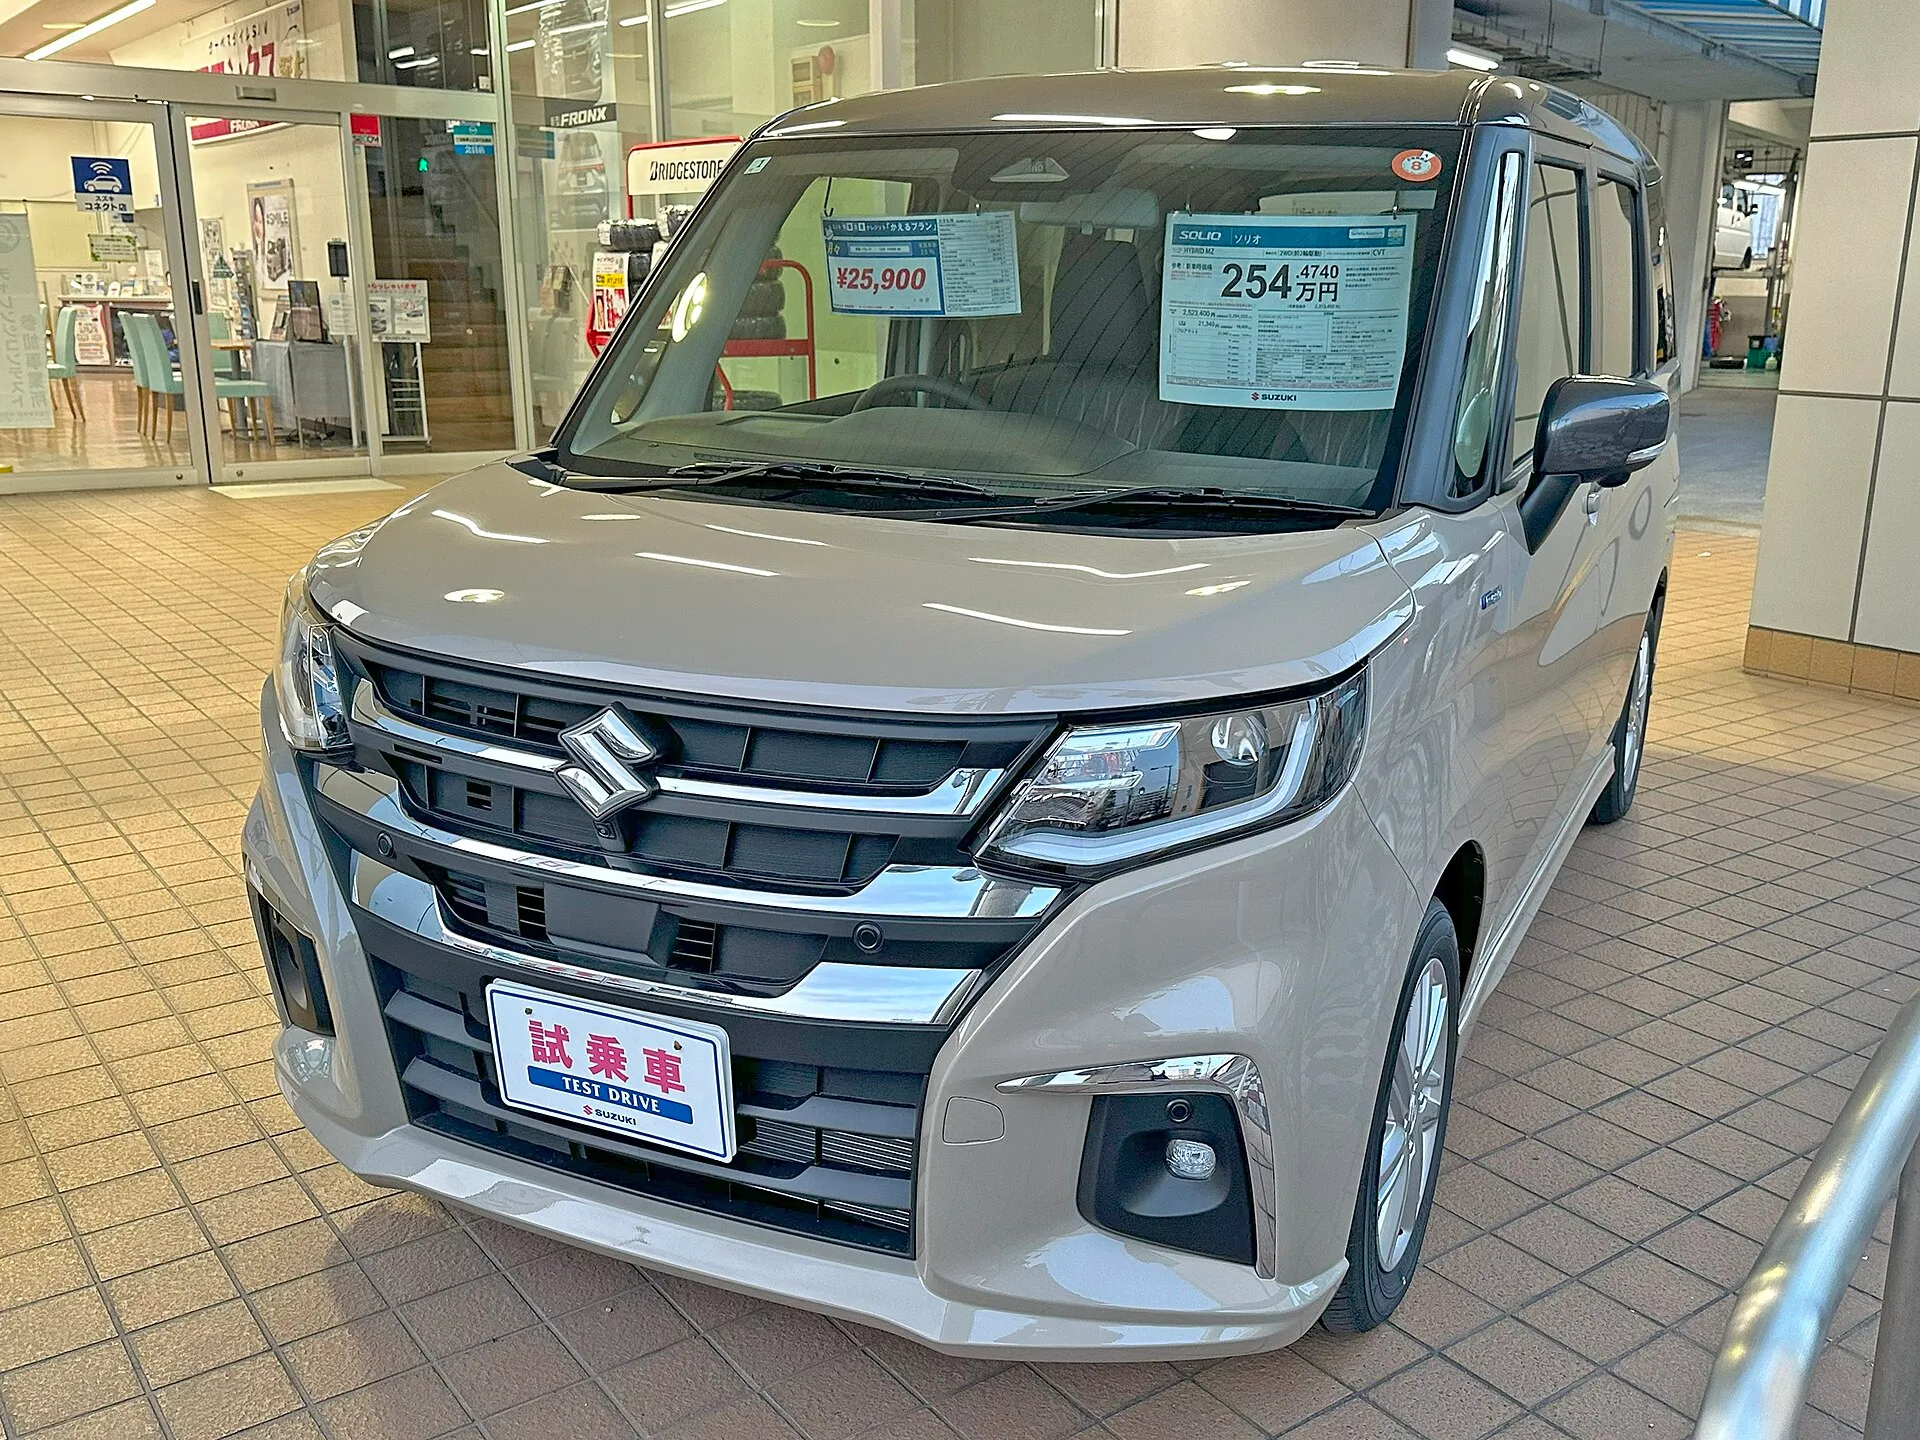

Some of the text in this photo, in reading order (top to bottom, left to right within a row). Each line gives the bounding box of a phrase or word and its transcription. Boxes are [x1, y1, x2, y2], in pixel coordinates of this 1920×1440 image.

[561, 106, 607, 127] FRONX
[650, 159, 724, 181] BRIDGESTONE
[1411, 160, 1422, 170] 8
[84, 202, 127, 212] コネクト店
[1179, 230, 1222, 241] SOLIO
[1234, 234, 1261, 245] ソリオ
[1183, 247, 1205, 255] HYBRID
[836, 267, 926, 294] ¥25,900
[1221, 263, 1292, 299] 254
[1295, 282, 1338, 302] 万円
[1261, 394, 1297, 402] SUZUKI
[528, 1019, 686, 1094] 試乗車
[562, 1076, 661, 1113] TEST DRIVE
[595, 1109, 637, 1126] SUZUKI
